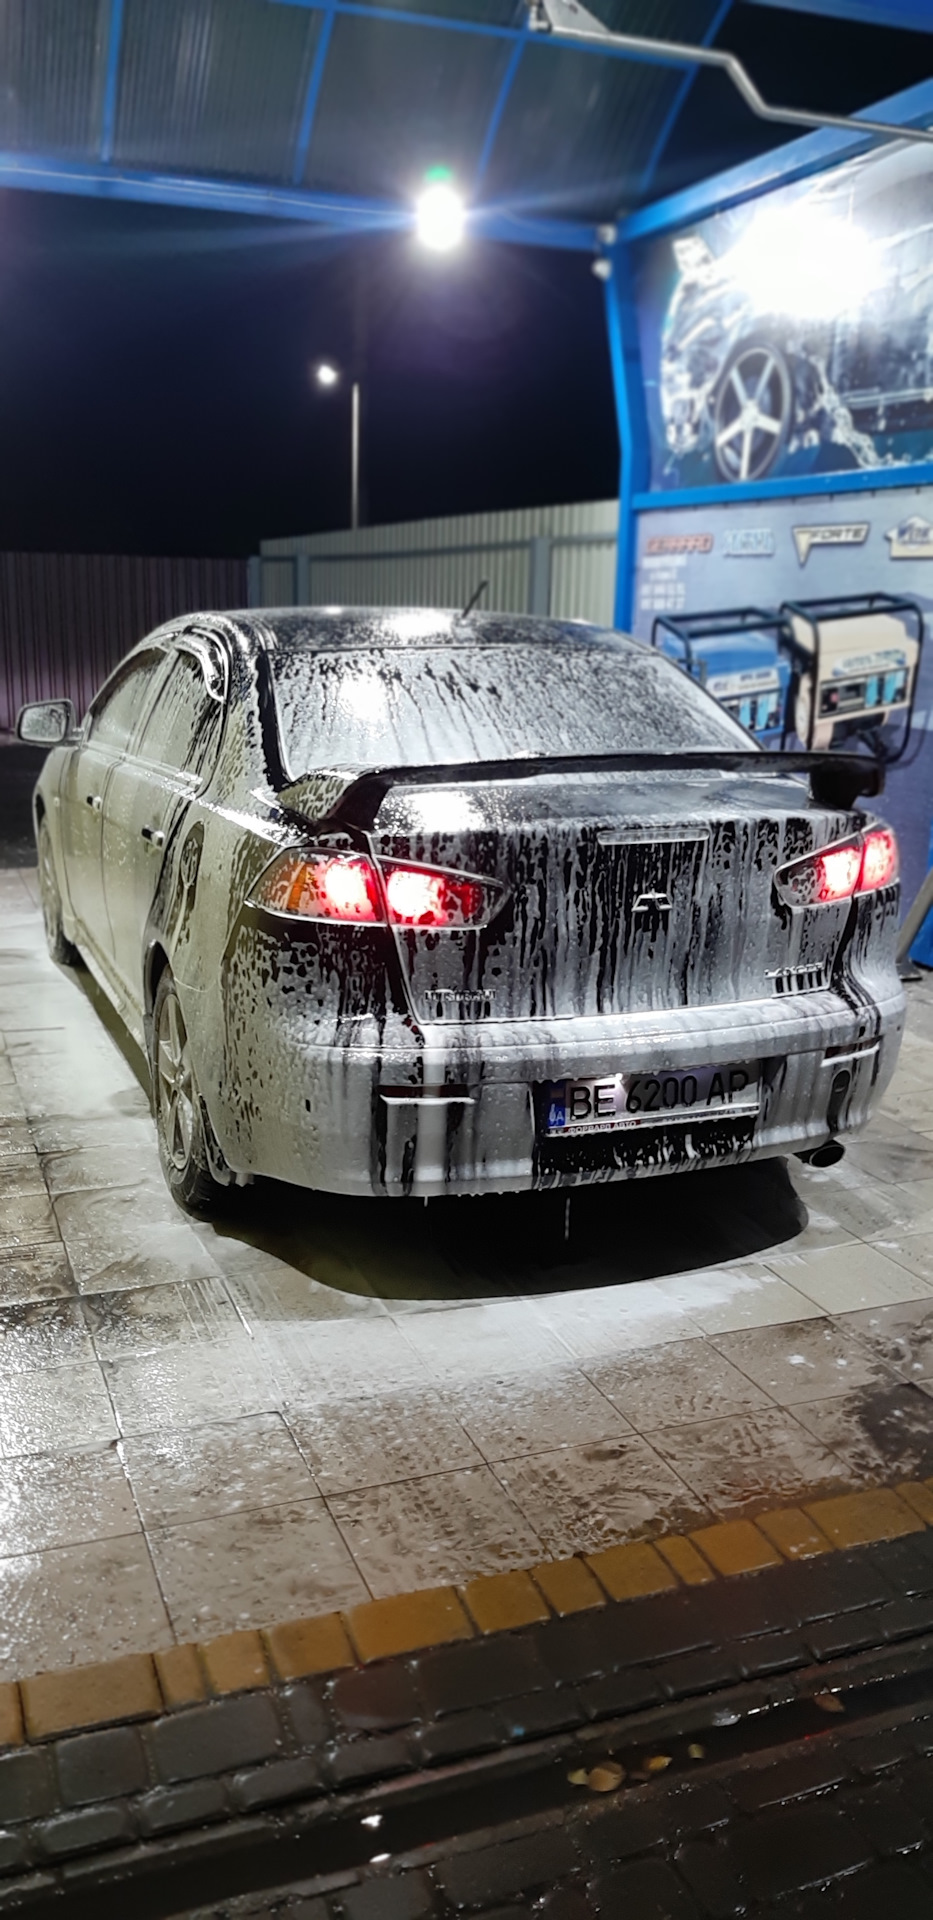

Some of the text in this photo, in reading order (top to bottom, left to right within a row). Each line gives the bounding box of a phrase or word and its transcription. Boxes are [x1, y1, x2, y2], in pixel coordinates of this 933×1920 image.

[569, 1083, 616, 1121] BE
[625, 1075, 698, 1114] 6200
[706, 1069, 749, 1106] AP
